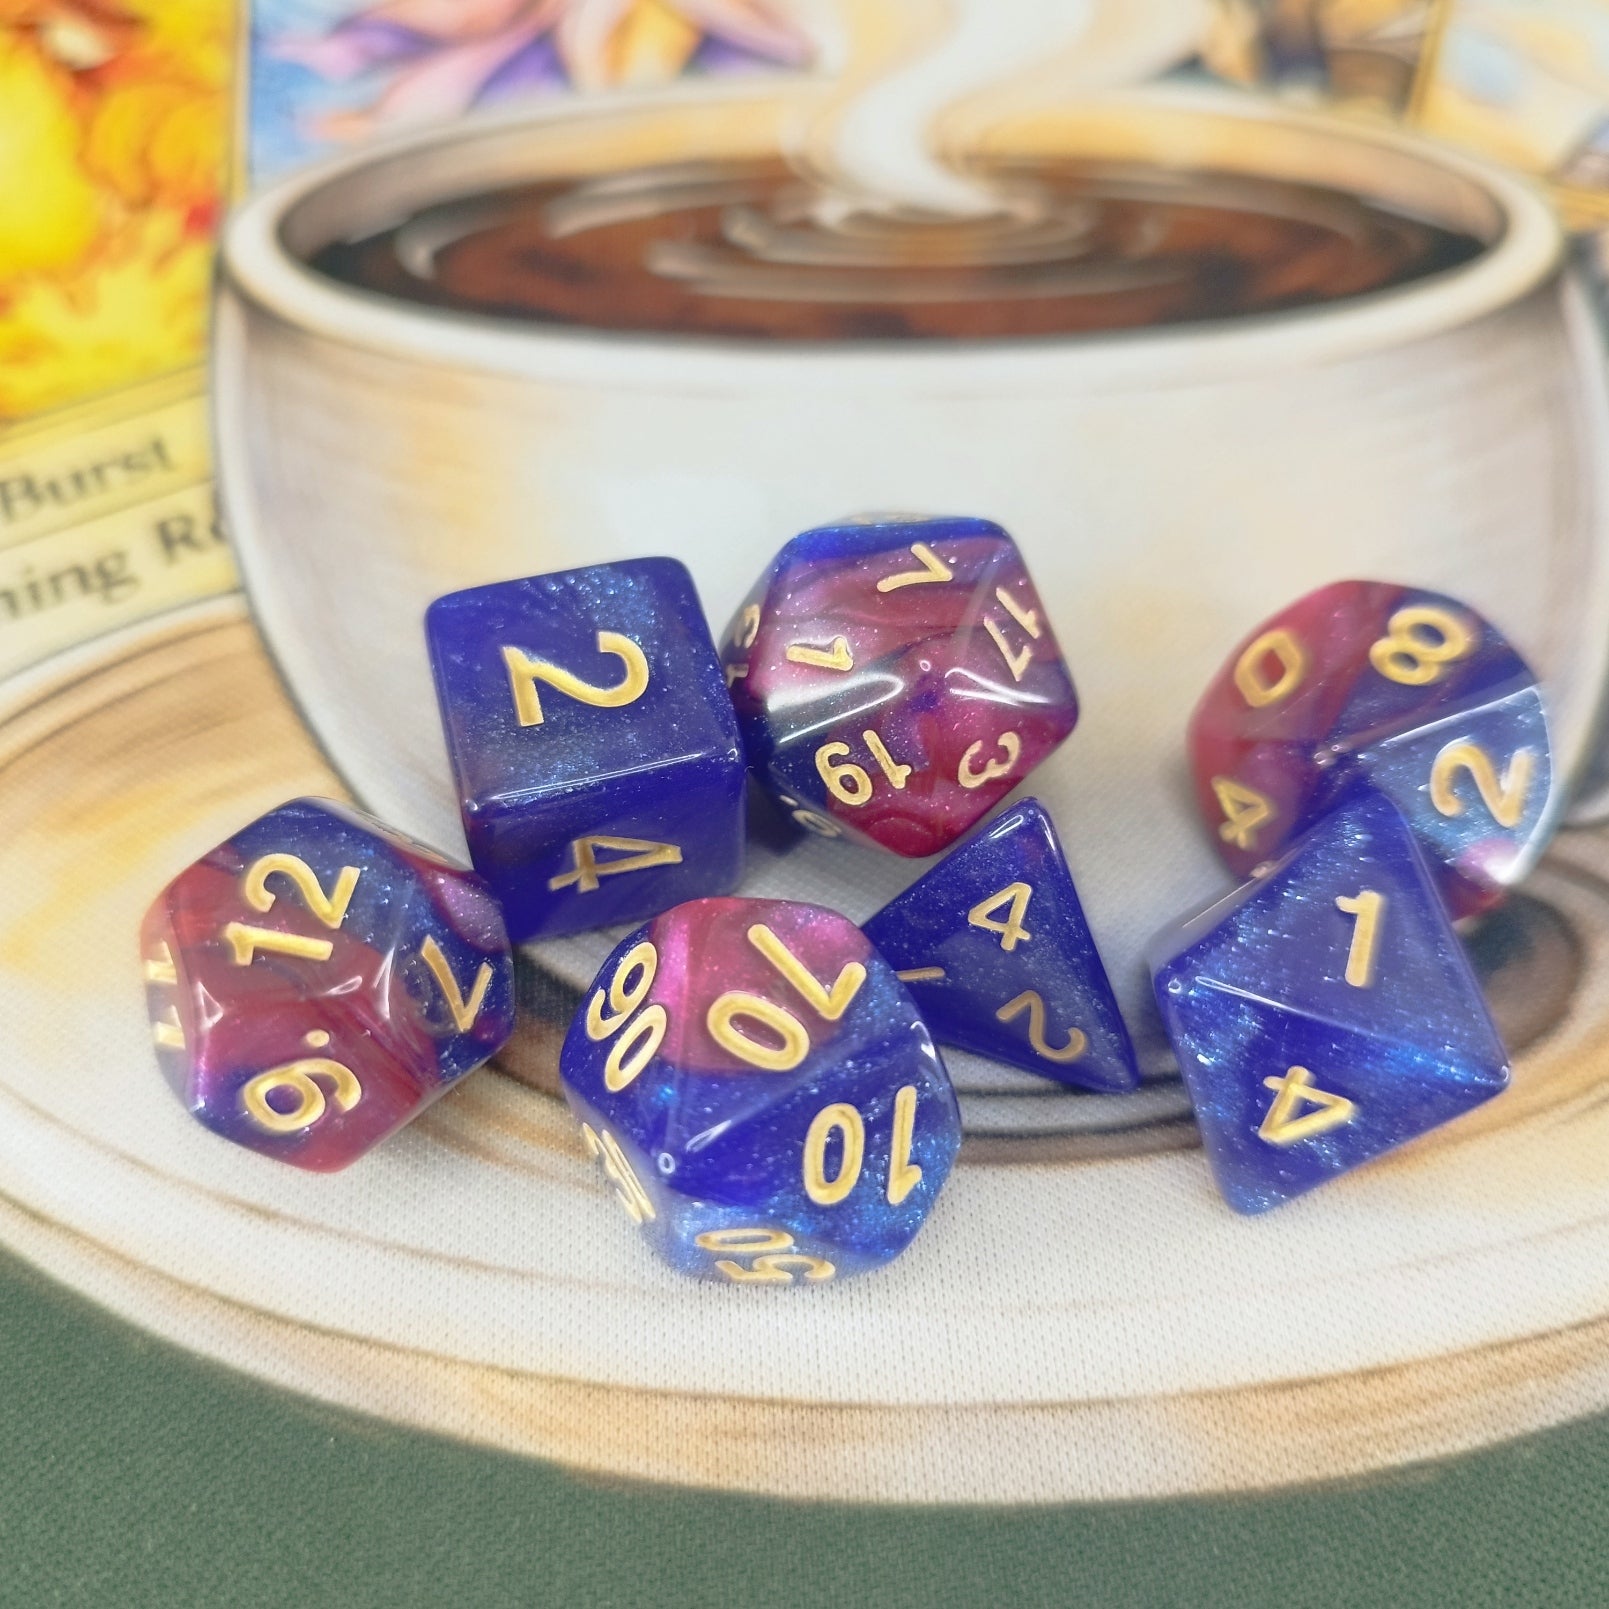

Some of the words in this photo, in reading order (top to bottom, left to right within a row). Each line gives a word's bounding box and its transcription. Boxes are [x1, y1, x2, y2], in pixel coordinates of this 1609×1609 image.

[0, 437, 176, 522] Burst
[877, 544, 953, 592] 7
[983, 588, 1041, 681] 17
[1235, 628, 1303, 707] 0
[1370, 607, 1468, 685] 8
[503, 631, 649, 727] 2
[815, 730, 912, 806] 19
[958, 732, 1020, 789] 3
[1431, 742, 1535, 828] 2
[1211, 776, 1272, 851] 4
[548, 836, 683, 893] 4
[223, 853, 361, 966] 12
[967, 882, 1032, 951] 4
[1336, 890, 1383, 986] 1
[421, 934, 493, 1034] 7
[707, 924, 867, 1071] 70
[996, 990, 1086, 1063] 2
[1258, 1065, 1355, 1144] 4
[803, 1086, 922, 1205] 10
[695, 1228, 836, 1282] 50
